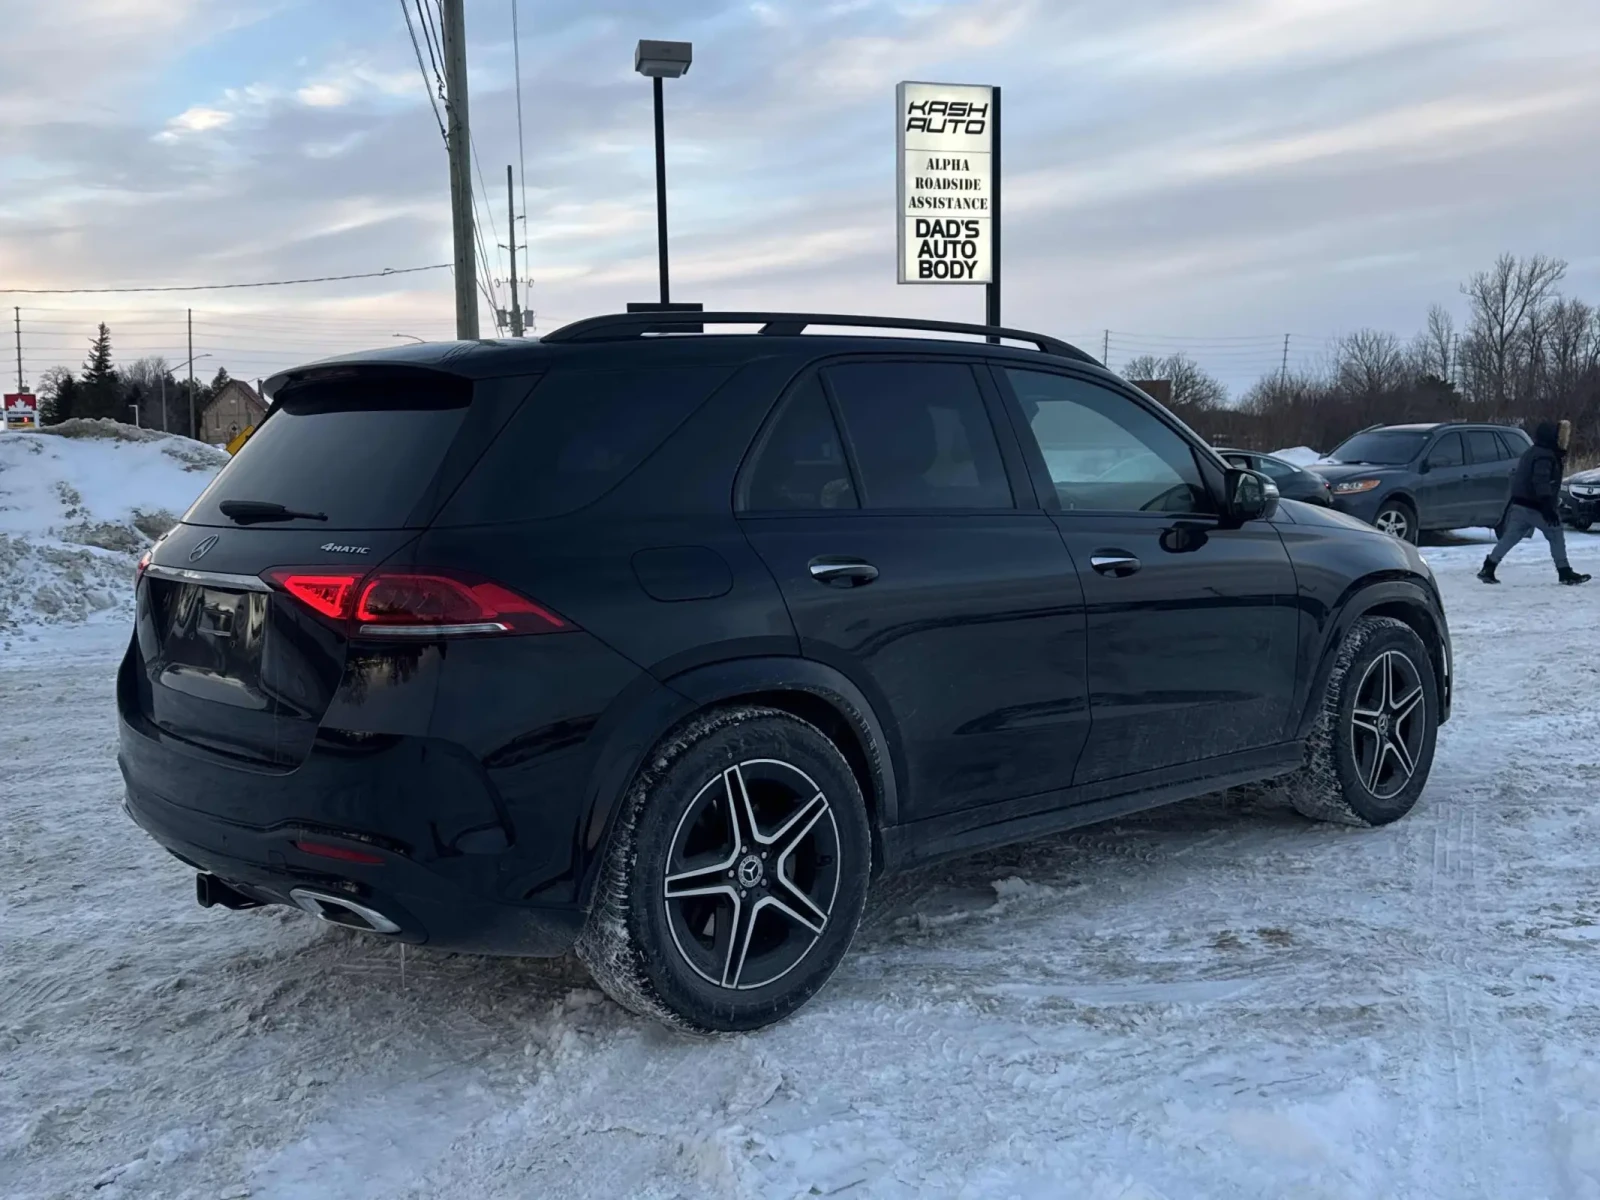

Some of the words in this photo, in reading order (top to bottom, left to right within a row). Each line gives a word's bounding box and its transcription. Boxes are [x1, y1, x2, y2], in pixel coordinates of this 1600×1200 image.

[908, 100, 988, 118] KASH
[906, 117, 985, 134] AUTO
[926, 158, 970, 171] ALPHA
[915, 177, 981, 191] ROADSIDE
[908, 196, 988, 210] ASSISTANCE
[915, 218, 980, 238] DAD'S
[917, 239, 977, 259] AUTO
[918, 259, 978, 279] BODY
[320, 542, 371, 554] 4MATIC
